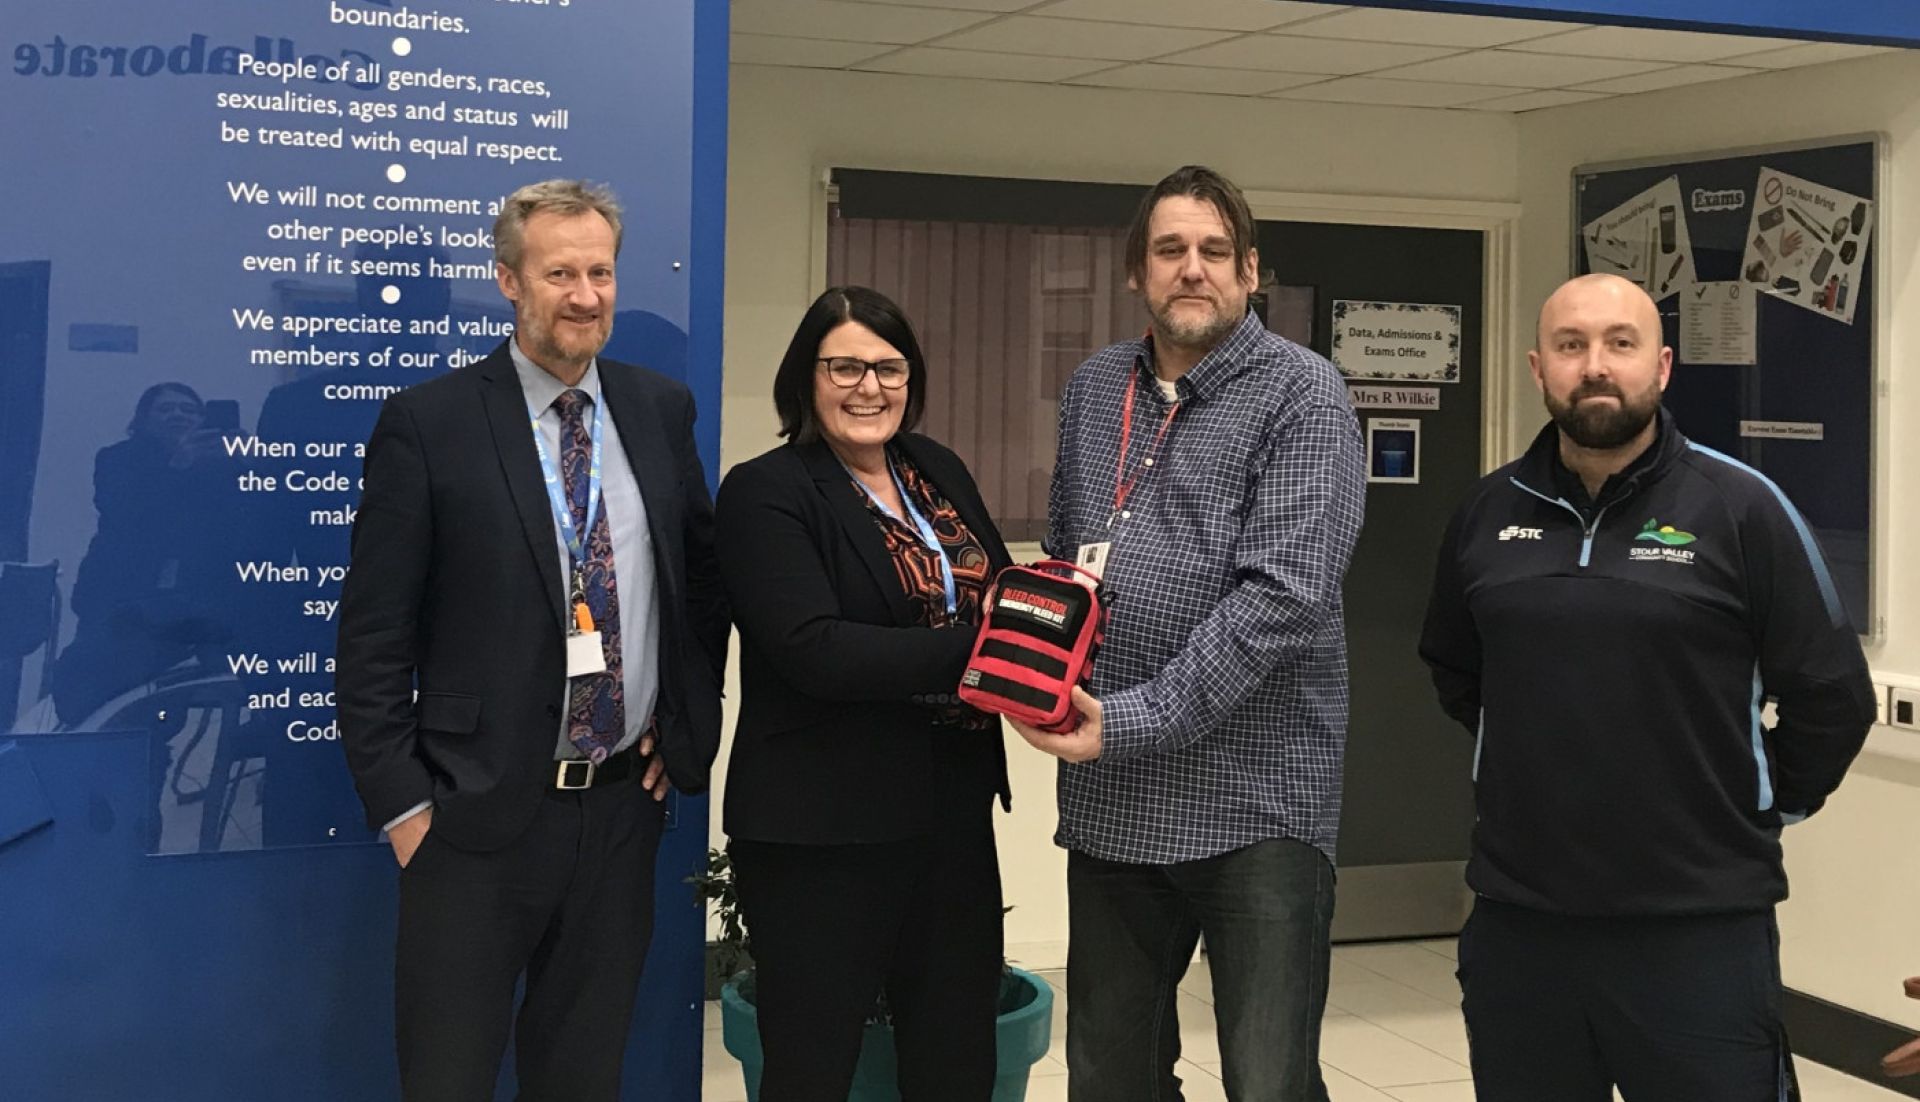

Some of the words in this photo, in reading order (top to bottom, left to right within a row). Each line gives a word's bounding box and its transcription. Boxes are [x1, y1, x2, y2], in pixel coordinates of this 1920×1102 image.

[330, 0, 470, 34] boundaries.
[238, 53, 317, 84] People
[324, 60, 351, 82] of
[355, 62, 381, 84] all
[386, 67, 483, 94] genders,
[487, 77, 551, 99] races,
[216, 90, 344, 118] sexualities,
[348, 100, 398, 124] ages
[404, 100, 446, 122] and
[453, 107, 518, 127] status
[531, 108, 569, 130] will
[221, 120, 250, 143] be
[257, 127, 343, 149] treated
[350, 130, 401, 153] with
[408, 135, 469, 160] equal
[476, 142, 563, 165] respect.
[226, 181, 270, 205] We
[276, 185, 317, 207] will
[325, 192, 366, 210] not
[372, 195, 482, 216] comment
[487, 195, 505, 217] a
[1694, 191, 1744, 209] Exams
[1786, 186, 1798, 198] Do
[1798, 189, 1813, 202] Not
[1814, 194, 1836, 212] Bring
[266, 218, 334, 242] other
[242, 255, 297, 273] even
[305, 251, 322, 273] if
[327, 254, 344, 275] it
[350, 259, 421, 277] seems
[232, 308, 274, 331] We
[281, 313, 402, 338] appreciate
[409, 314, 450, 335] and
[457, 315, 514, 337] value
[1348, 327, 1375, 339] Data,
[1377, 328, 1432, 341] Admissions
[1434, 330, 1443, 341] &
[250, 344, 360, 367] members
[368, 346, 393, 367] of
[398, 353, 440, 368] our
[1364, 345, 1396, 357] Exams
[1397, 347, 1427, 358] Office
[324, 384, 401, 400] comm
[1353, 390, 1379, 404] Mrs
[1382, 391, 1392, 404] R
[1395, 391, 1436, 405] Wilkie
[222, 435, 296, 457] When
[305, 443, 347, 457] our
[354, 443, 366, 458] a
[238, 470, 277, 492] the
[285, 469, 349, 492] Code
[310, 504, 357, 525] mak
[1518, 528, 1544, 540] STC
[1630, 547, 1660, 556] STOUR
[1661, 547, 1696, 560] VALLEY
[236, 561, 309, 582] When
[317, 566, 350, 587] yo
[304, 600, 339, 621] say
[1002, 588, 1028, 602] BLEED
[1027, 594, 1067, 614] CONTROL
[227, 653, 269, 674] We
[277, 652, 316, 673] will
[325, 657, 336, 673] a
[248, 687, 290, 710] and
[298, 691, 336, 707] eac
[287, 719, 341, 742] Cod
